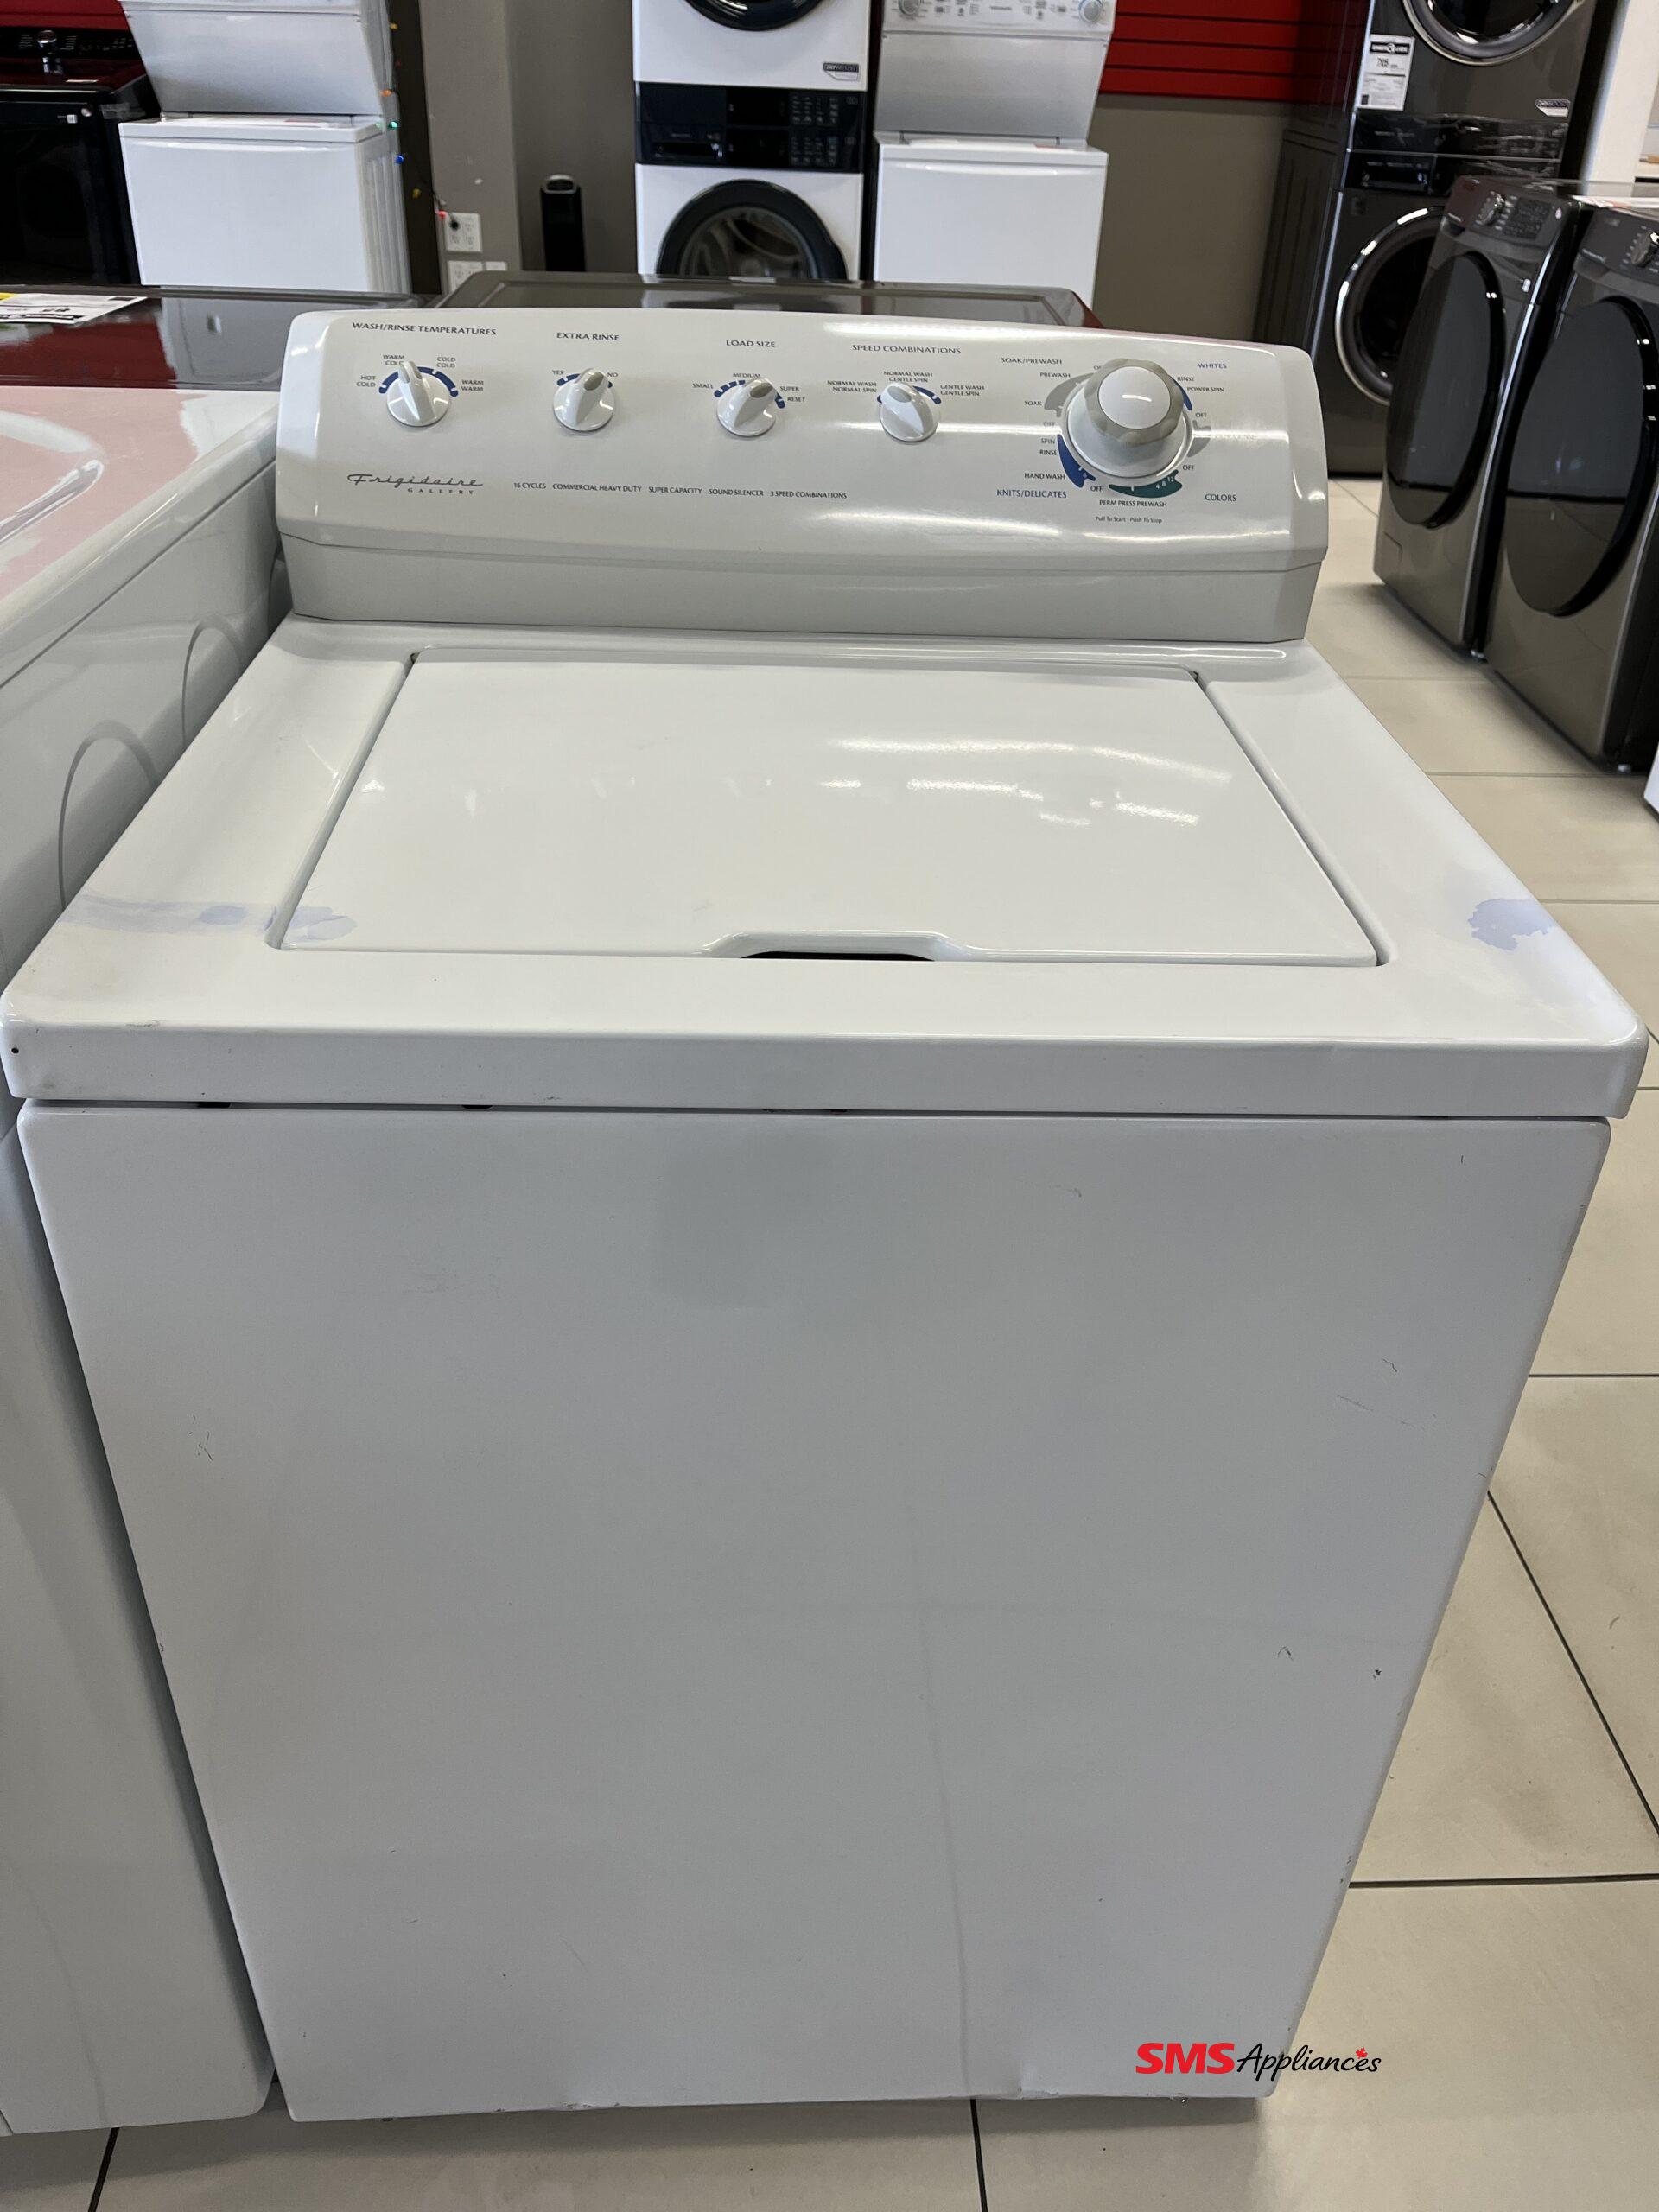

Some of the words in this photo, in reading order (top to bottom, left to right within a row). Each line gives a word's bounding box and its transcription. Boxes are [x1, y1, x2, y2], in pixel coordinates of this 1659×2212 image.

[352, 322, 416, 332] WASH/RINSE
[418, 325, 497, 335] TEMPERATURES
[883, 346, 961, 354] COMBINATIONS
[346, 474, 483, 488] Frigidaire
[996, 489, 1067, 499] KNITS/DELICATES
[1205, 493, 1236, 502] COLORS
